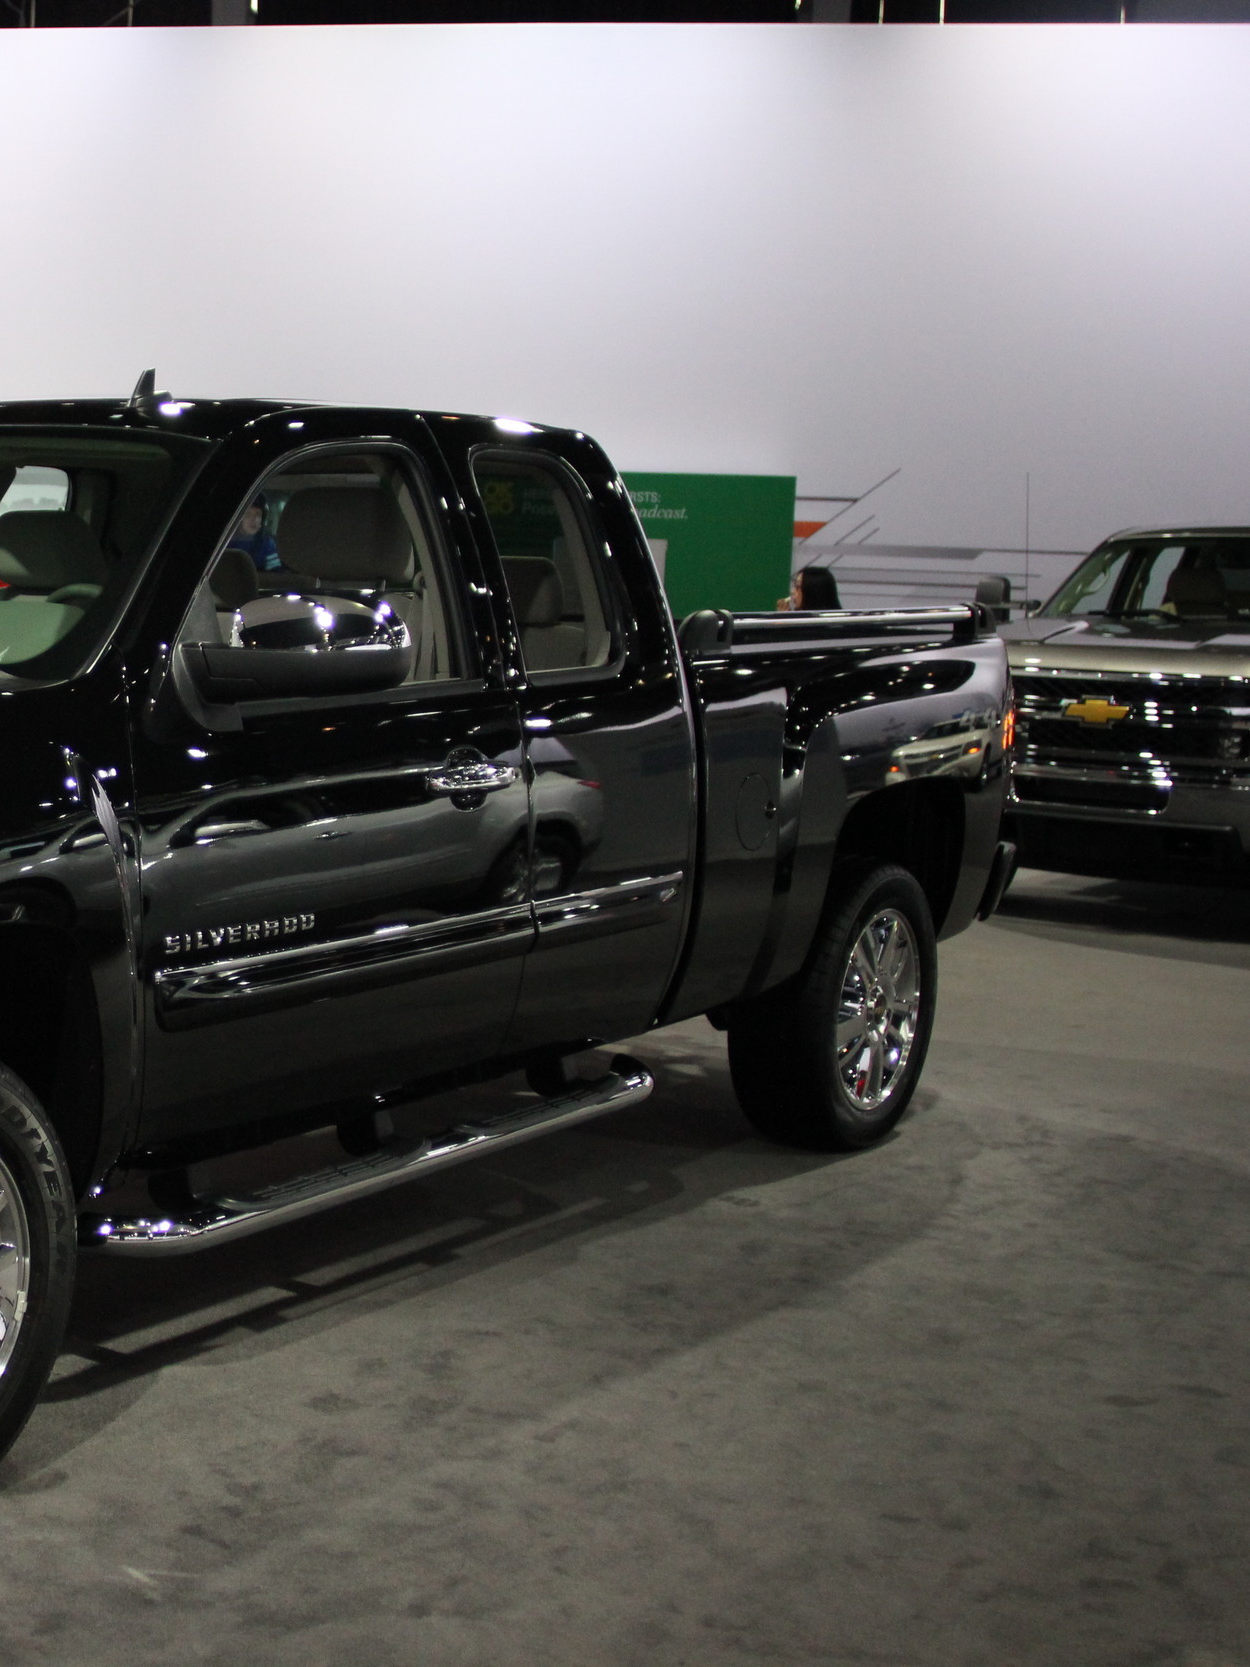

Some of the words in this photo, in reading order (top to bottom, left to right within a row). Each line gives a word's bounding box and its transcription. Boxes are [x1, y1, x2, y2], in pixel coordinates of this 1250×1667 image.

[629, 491, 661, 503] RSTS:
[636, 504, 688, 519] adcast.
[164, 912, 316, 955] SILVERADO
